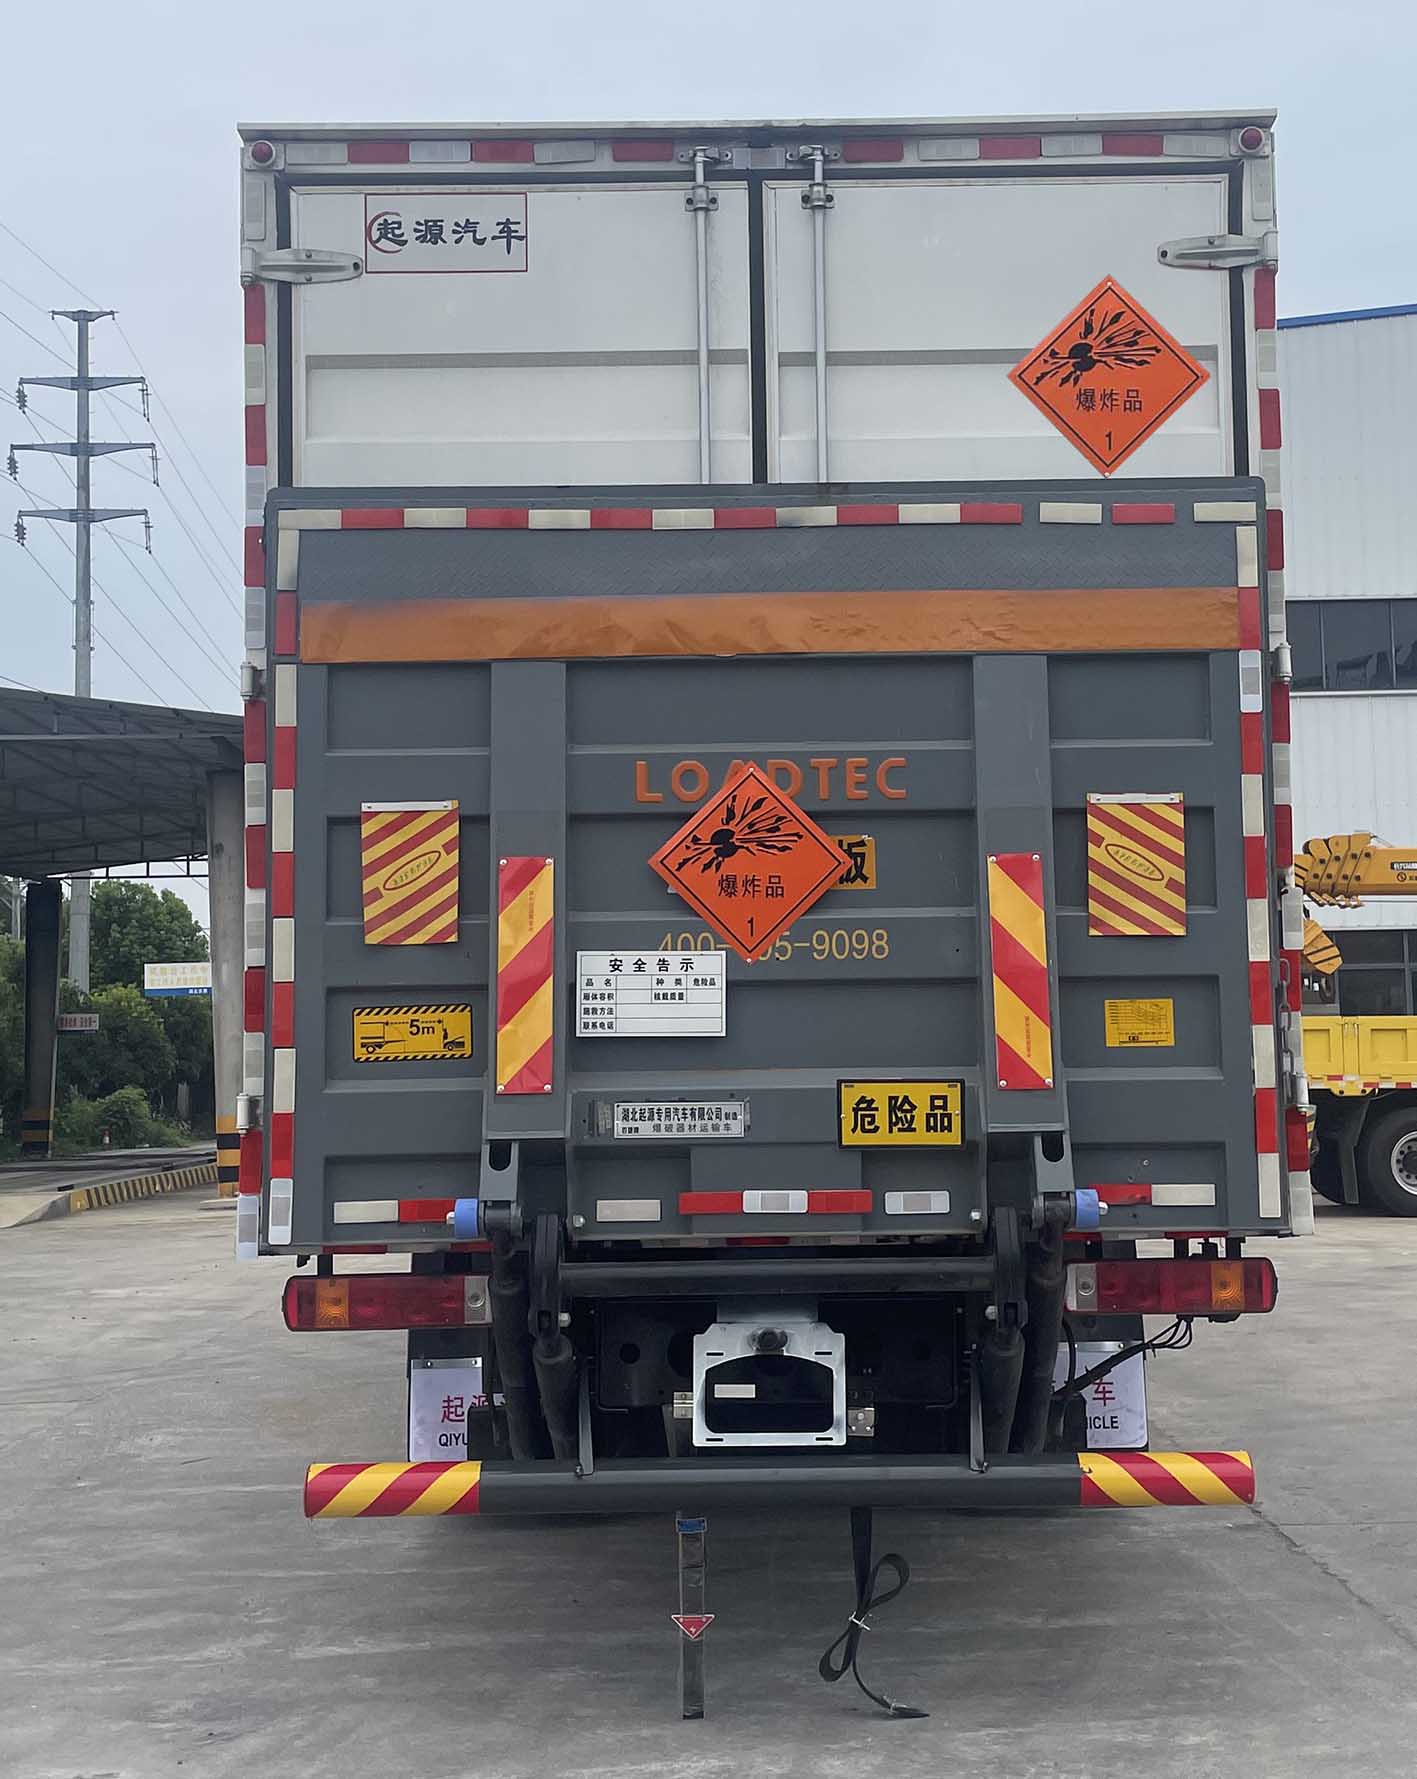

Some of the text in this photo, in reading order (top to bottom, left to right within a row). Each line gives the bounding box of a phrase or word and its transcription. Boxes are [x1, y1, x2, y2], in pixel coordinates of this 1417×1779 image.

[374, 218, 525, 256] 起源汽车
[1076, 387, 1143, 413] 爆炸品
[1105, 431, 1113, 451] 1
[718, 874, 785, 899] 爆炸品
[747, 916, 755, 937] 1
[658, 928, 890, 960] 400-5-9098
[609, 957, 695, 973] 安全告示
[408, 1018, 436, 1037] 5m
[851, 1095, 953, 1134] 危险品
